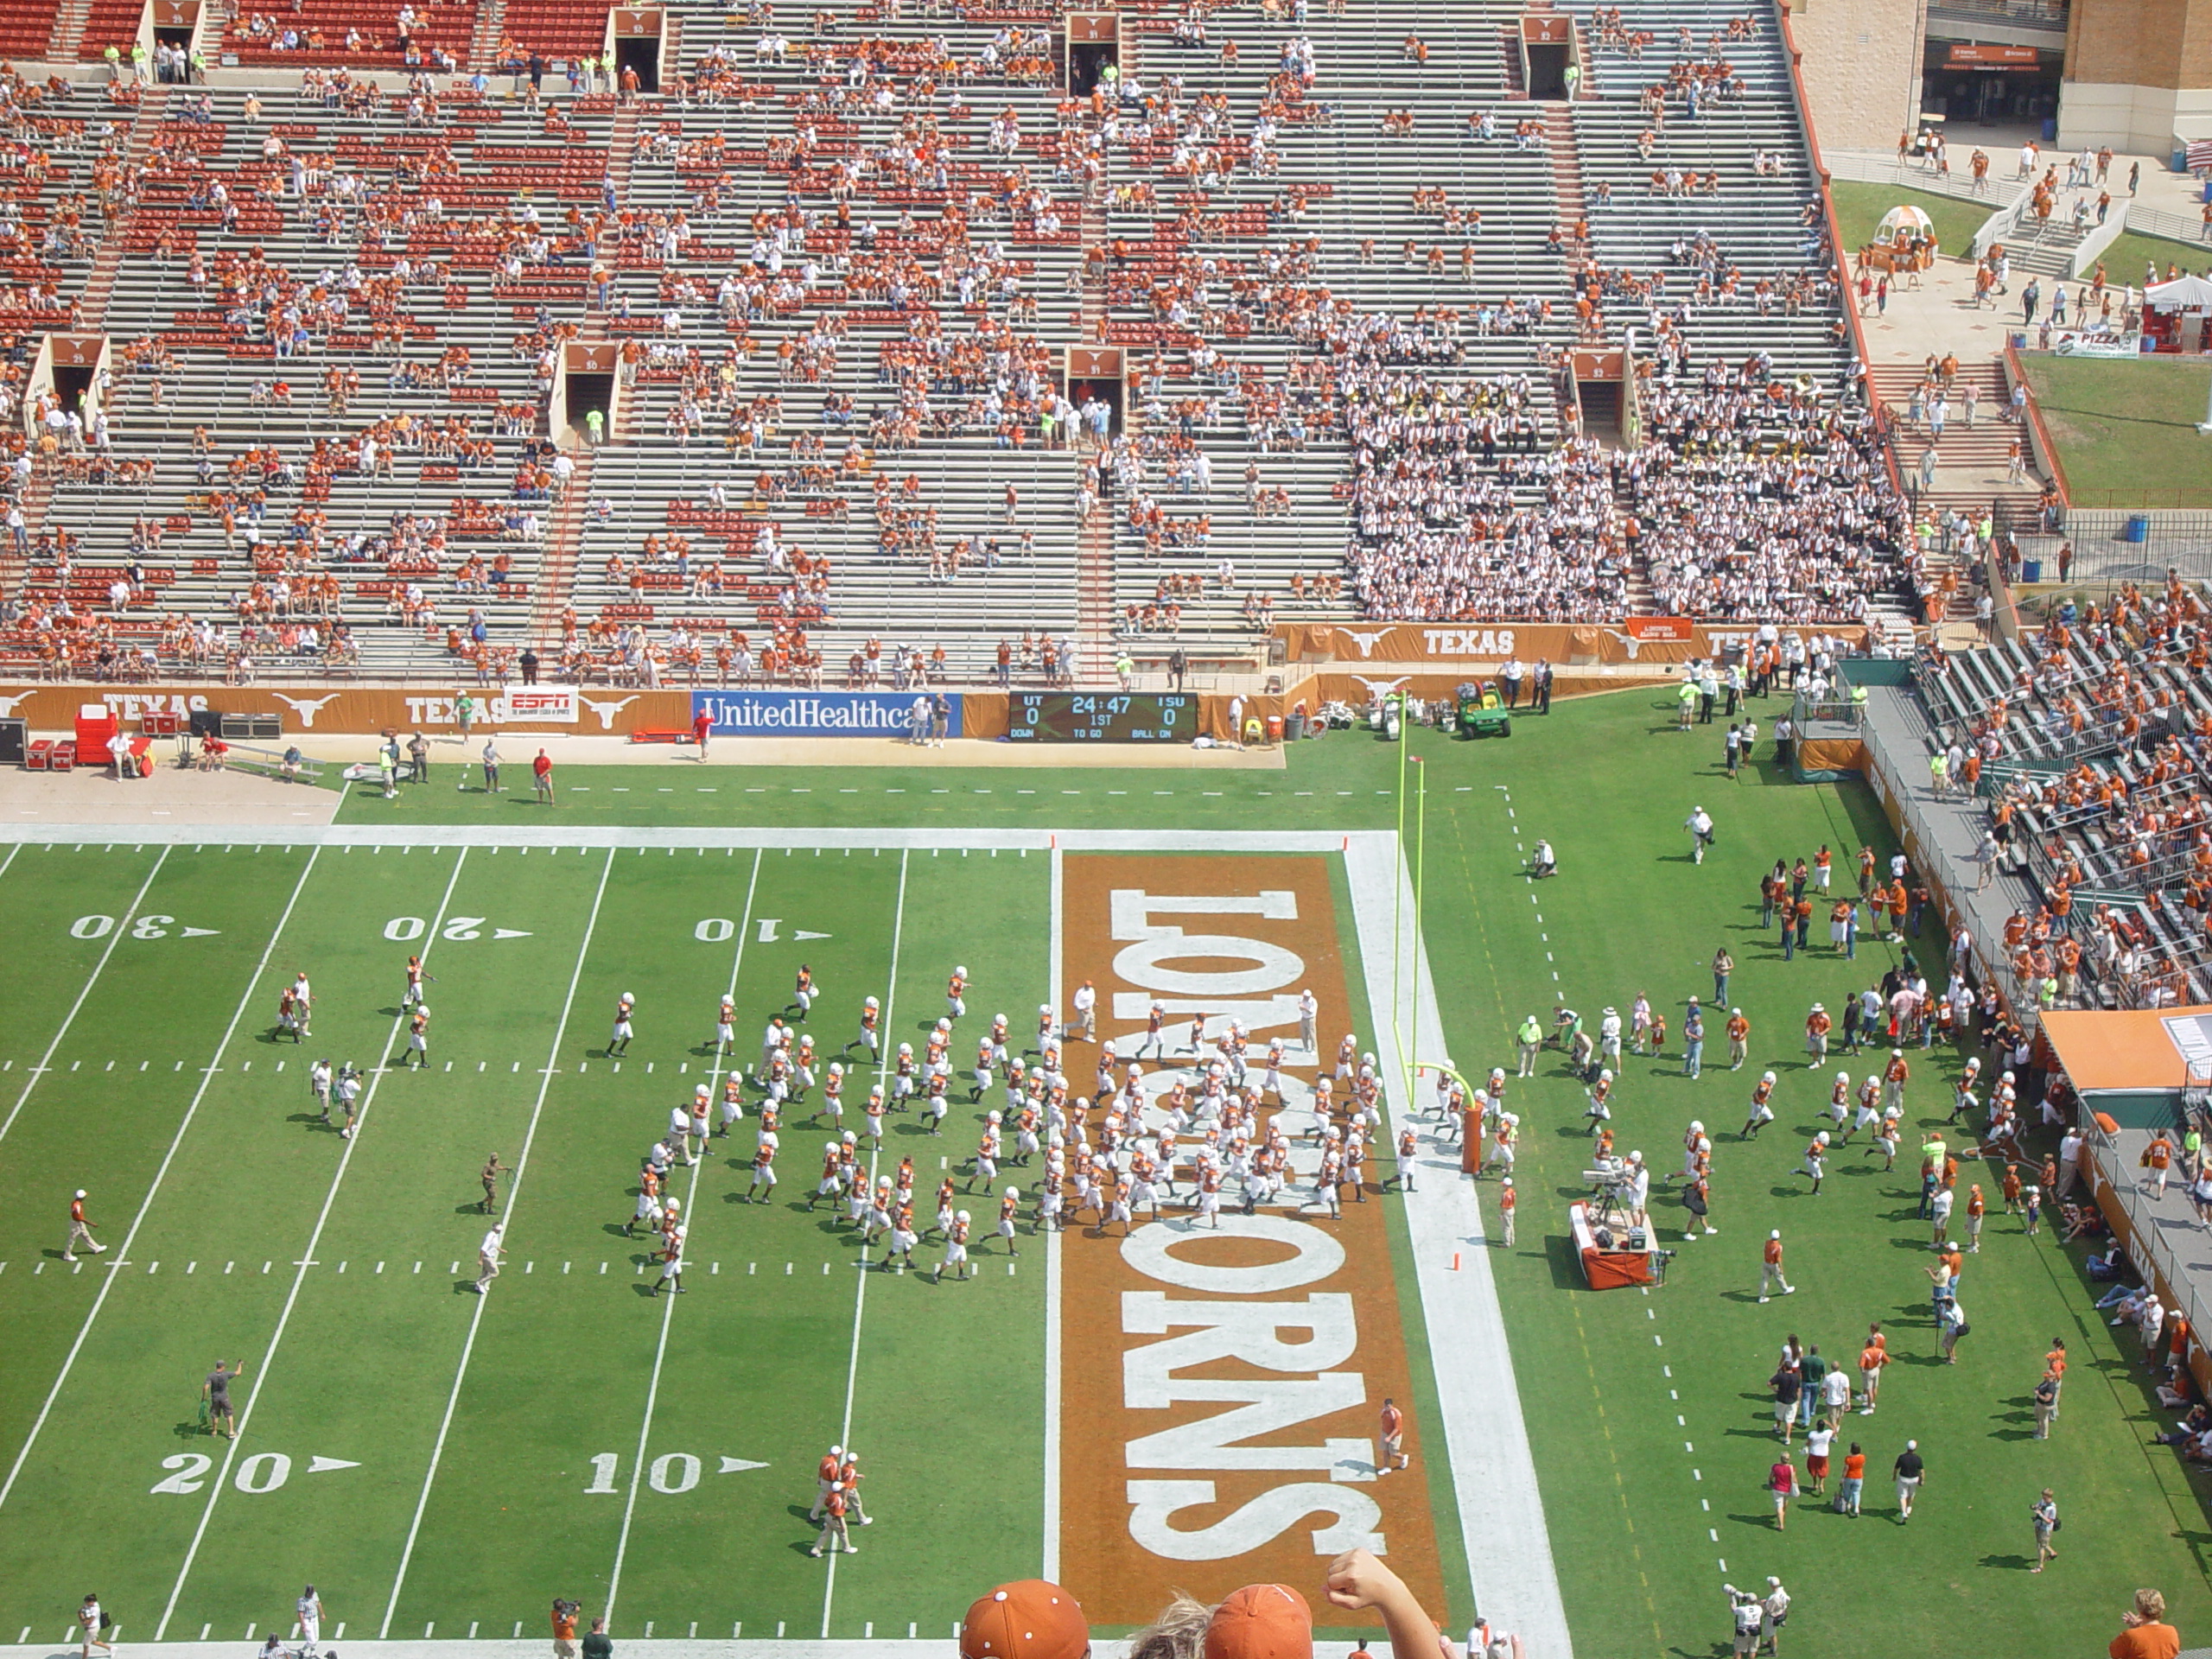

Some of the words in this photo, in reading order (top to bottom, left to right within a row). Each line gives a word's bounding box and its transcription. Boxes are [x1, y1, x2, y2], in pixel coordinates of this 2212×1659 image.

[2082, 334, 2120, 345] PIZZA
[73, 353, 85, 364] 29
[1593, 368, 1604, 378] 32
[1423, 630, 1515, 654] TEXAS
[103, 693, 208, 721] TEXAS
[405, 697, 505, 724] TEXAS
[512, 694, 569, 708] ESPN
[1024, 696, 1043, 706] UT
[1072, 696, 1131, 714] 24:47
[1158, 696, 1185, 707] ISU
[702, 697, 917, 728] UnitedHealthca
[1026, 708, 1039, 725] 0
[1163, 709, 1176, 726] 0
[1090, 715, 1112, 726] 1ST
[1010, 728, 1034, 738] DOWN
[1074, 729, 1086, 738] TO
[1090, 729, 1103, 738] GO
[1132, 729, 1154, 738] BALL
[1159, 729, 1172, 738] ON
[1110, 889, 1387, 1561] LONGHORNS
[2129, 1229, 2156, 1294] TEXAS
[150, 1453, 292, 1494] 20
[584, 1453, 702, 1494] 10
